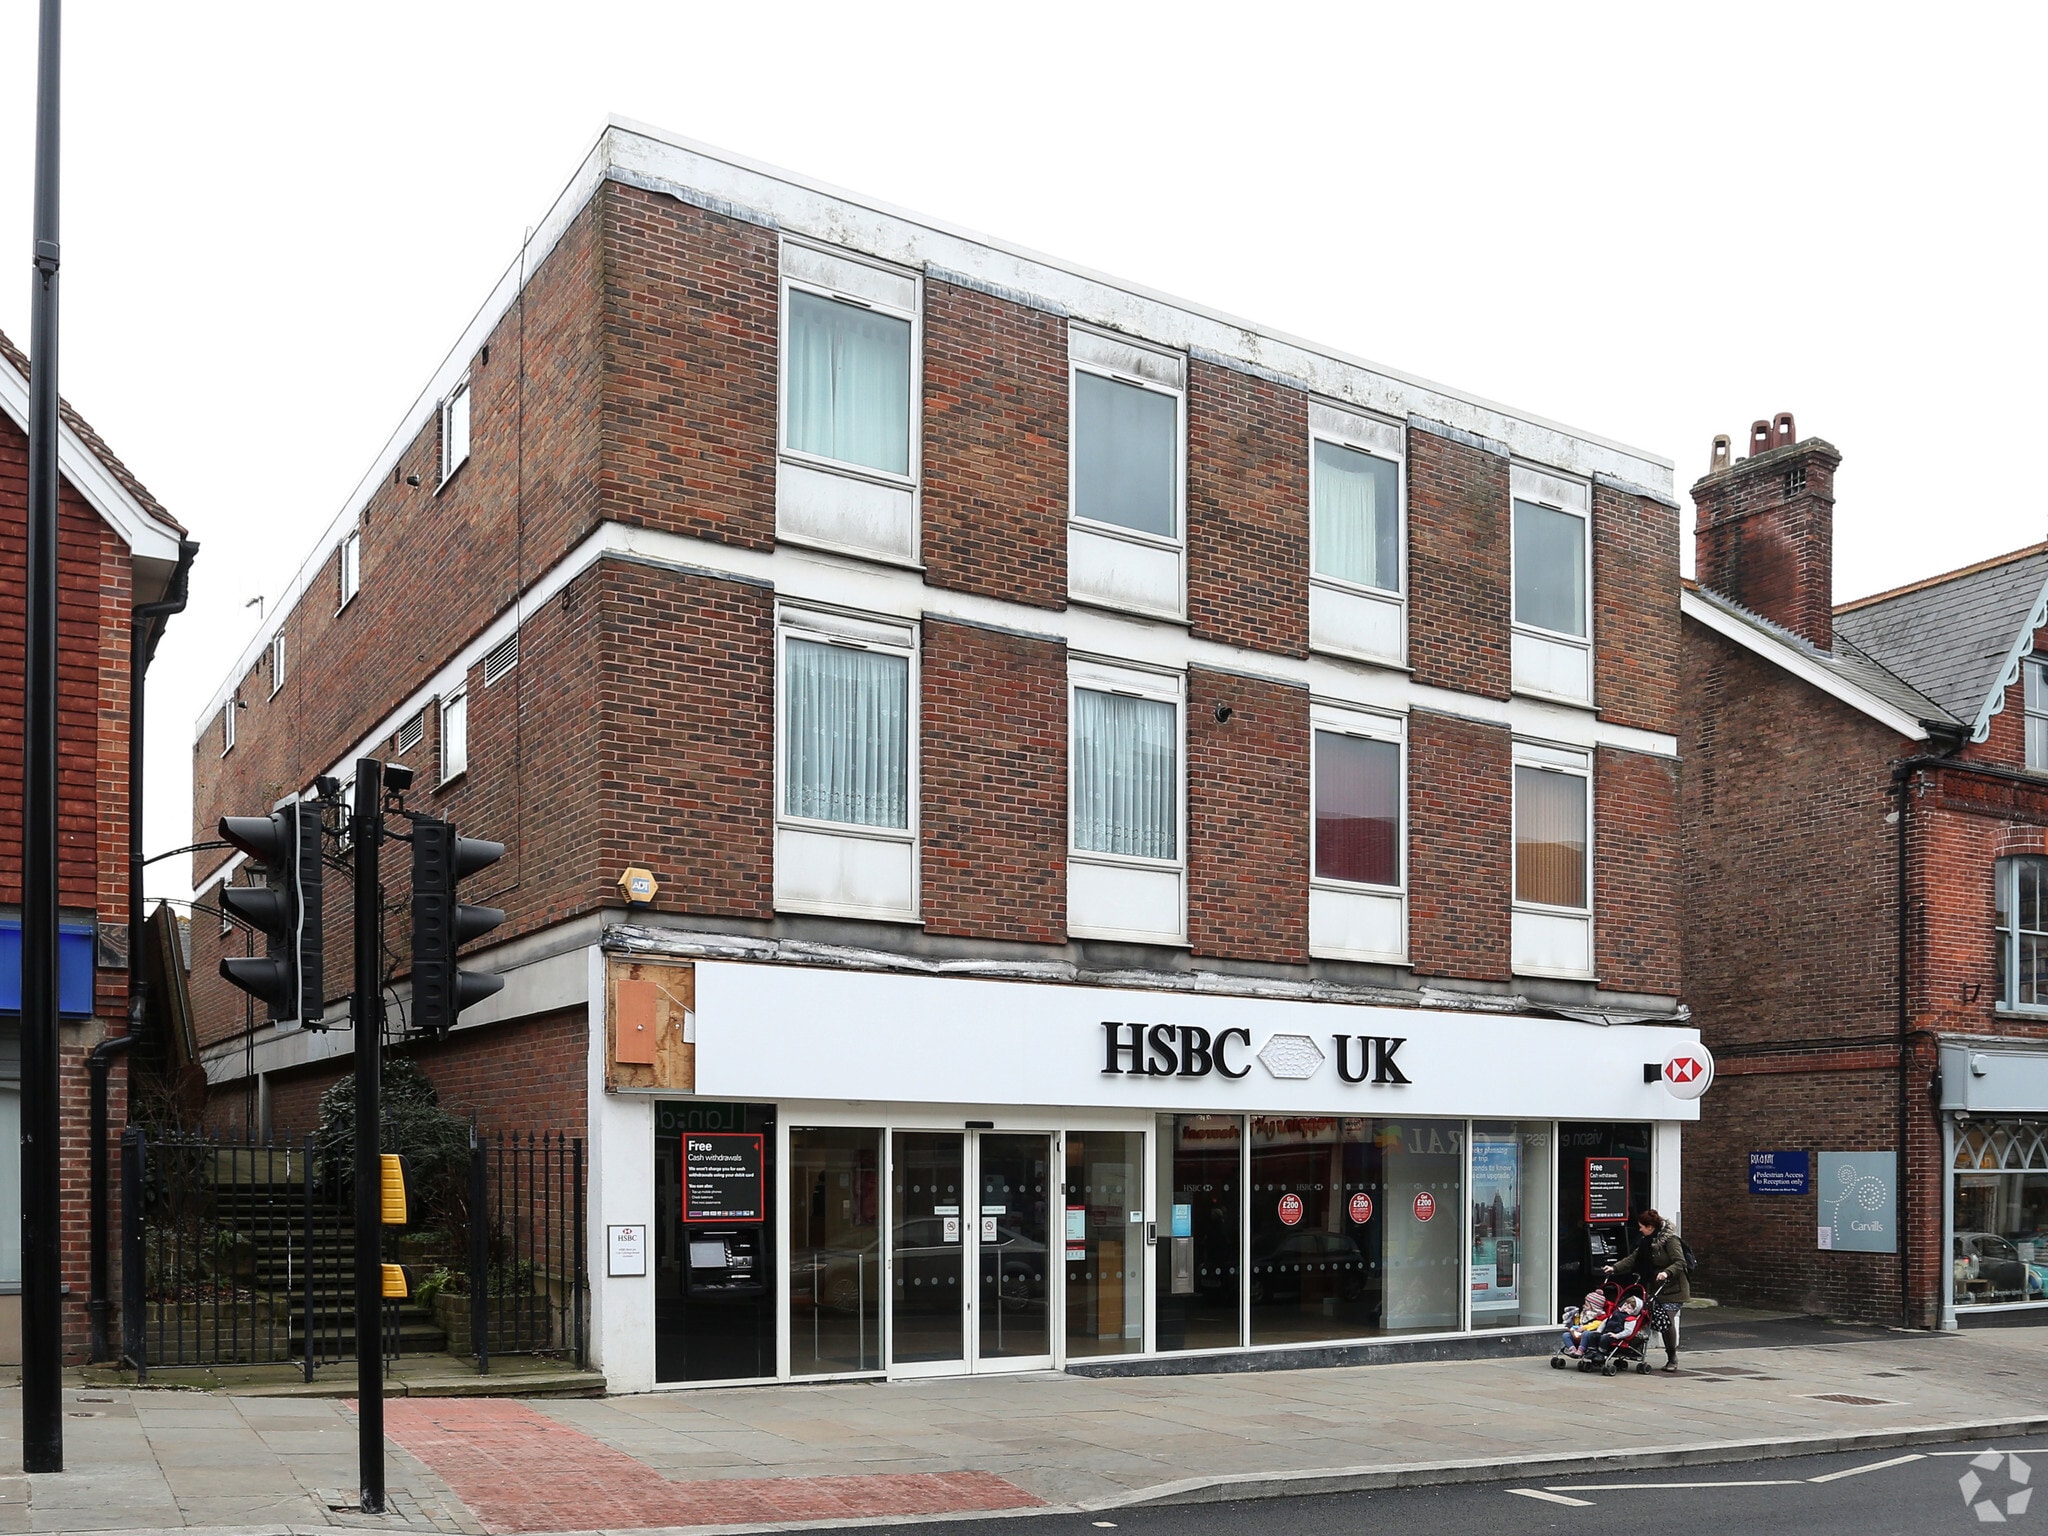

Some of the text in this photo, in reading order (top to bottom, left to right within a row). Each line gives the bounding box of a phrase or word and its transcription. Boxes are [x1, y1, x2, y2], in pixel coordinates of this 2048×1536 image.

[632, 880, 649, 891] ADT
[1100, 1021, 1413, 1085] HSBC UK
[688, 1140, 713, 1151] Free
[688, 1153, 742, 1162] Cash withdrawals
[1590, 1162, 1603, 1171] Free
[1763, 1178, 1790, 1186] Reception
[1790, 1178, 1803, 1187] only
[1282, 1201, 1299, 1209] £200
[1353, 1200, 1369, 1208] £200
[1417, 1199, 1432, 1207] £200
[1851, 1220, 1884, 1232] Carvills
